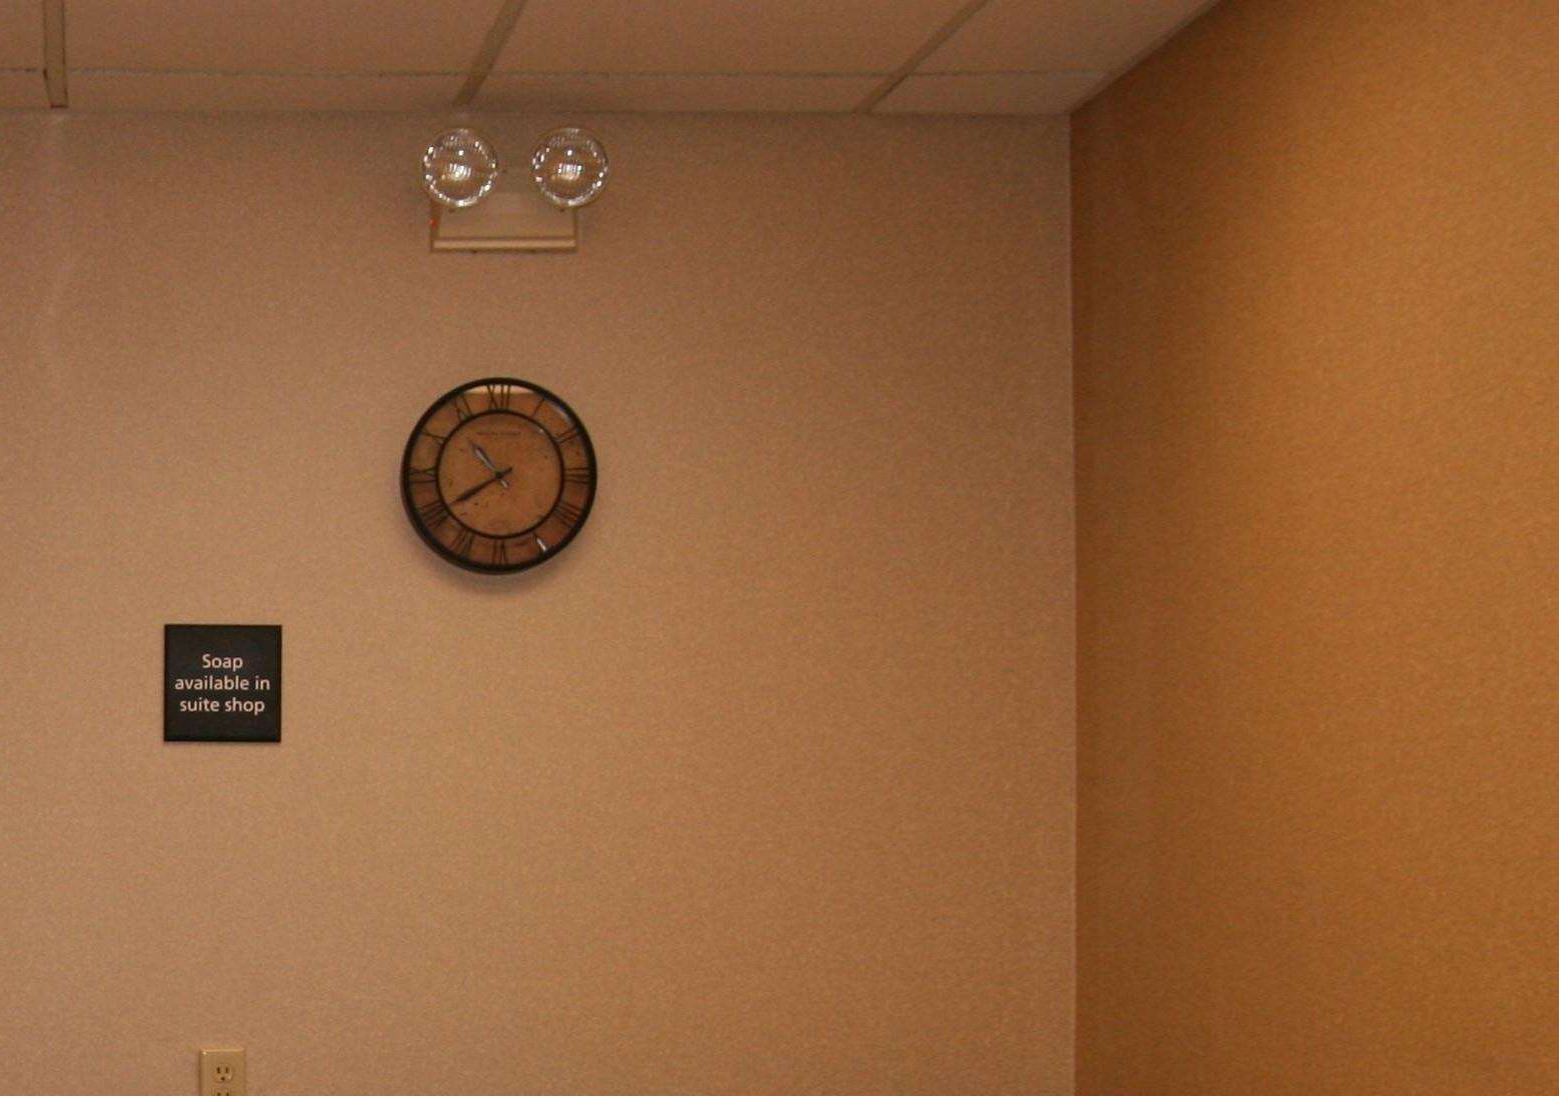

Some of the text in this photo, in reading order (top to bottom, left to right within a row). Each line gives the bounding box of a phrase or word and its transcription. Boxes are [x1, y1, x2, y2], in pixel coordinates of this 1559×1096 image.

[201, 653, 244, 672] Soap
[174, 674, 271, 691] available in
[179, 696, 266, 716] suite shop
